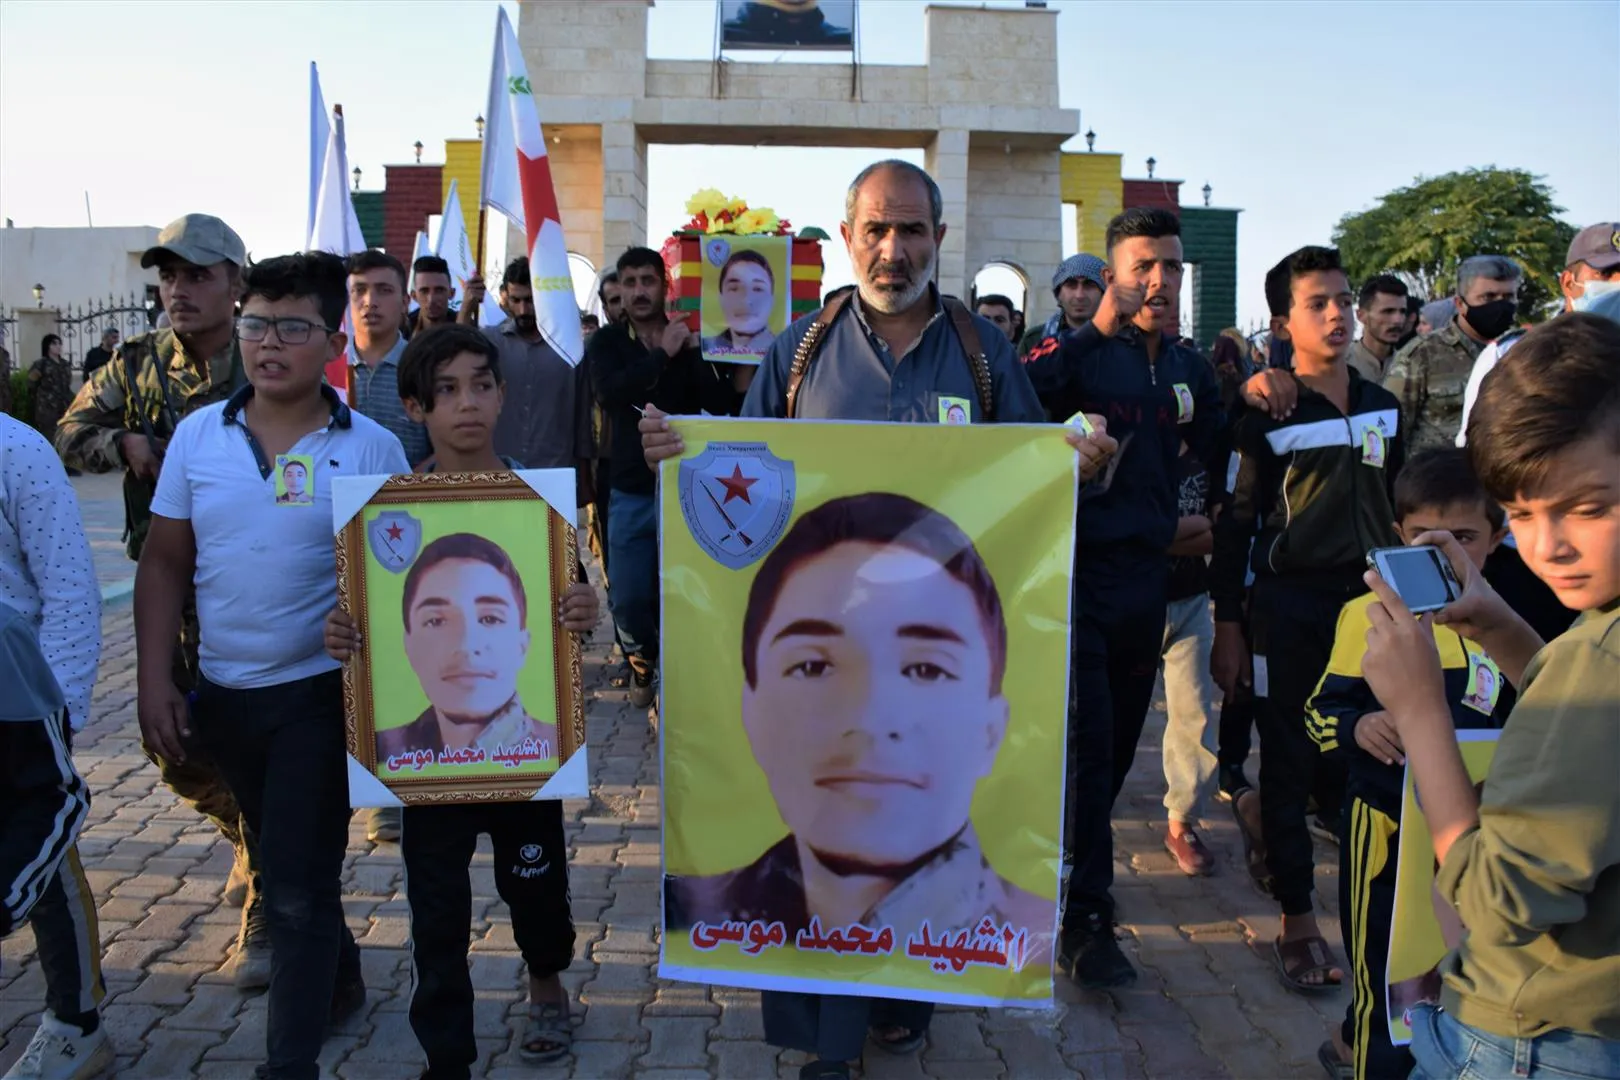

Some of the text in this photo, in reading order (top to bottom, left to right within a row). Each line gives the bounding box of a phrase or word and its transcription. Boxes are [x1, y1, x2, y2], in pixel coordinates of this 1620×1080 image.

[387, 737, 550, 771] الشهيد محمد موسى
[691, 916, 1026, 972] الشهيد محمد موسى
